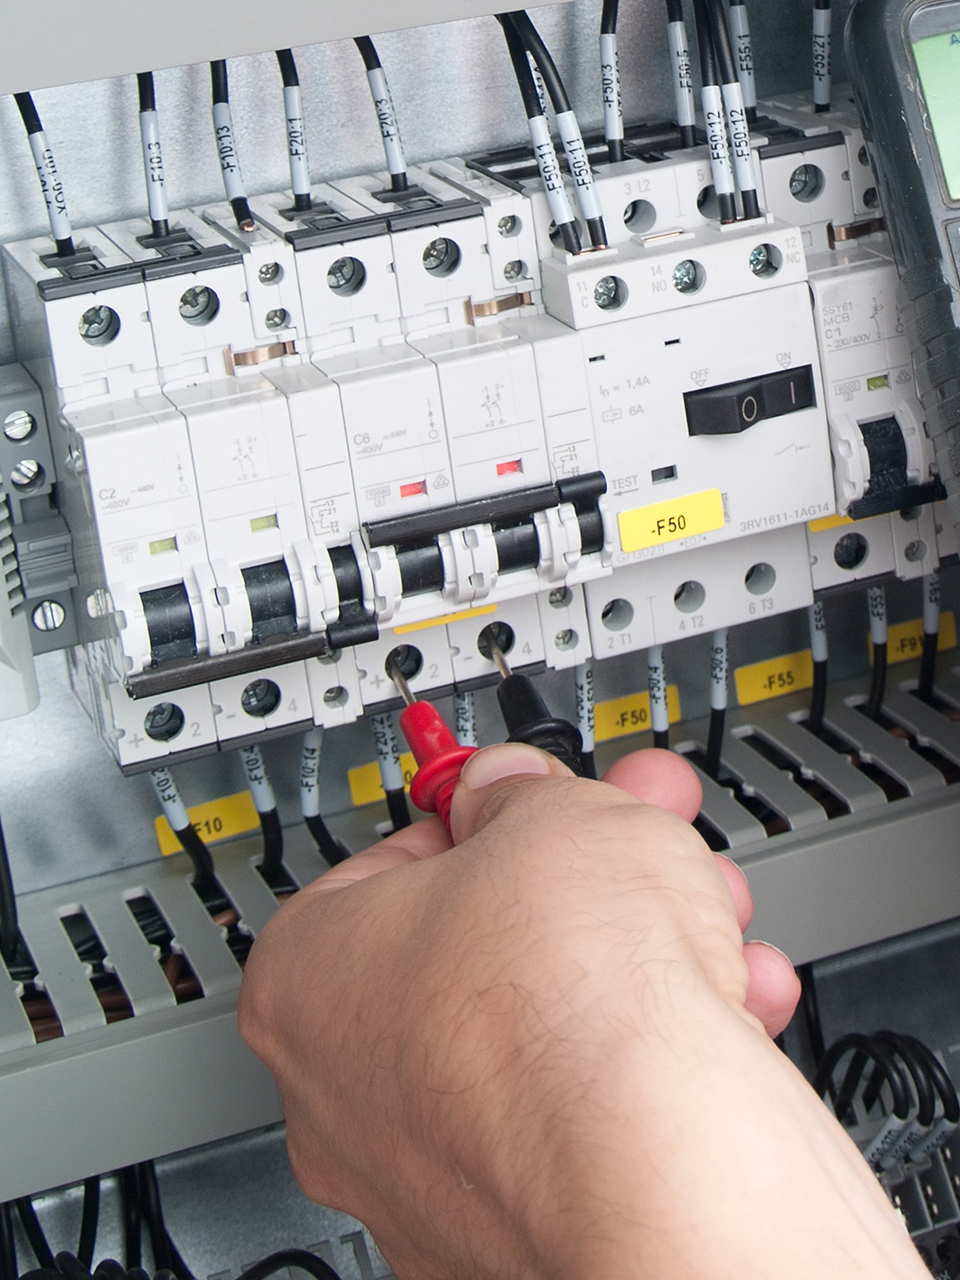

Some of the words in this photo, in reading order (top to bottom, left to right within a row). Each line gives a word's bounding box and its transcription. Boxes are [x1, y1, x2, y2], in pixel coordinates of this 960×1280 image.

[375, 97, 397, 142] -F20:3
[287, 116, 305, 161] -F20:1
[706, 110, 724, 165] -F50:12
[730, 107, 750, 162] -F50:12
[216, 125, 236, 173] -F10:13
[147, 141, 164, 187] -F10:3
[536, 142, 562, 195] -F50:11
[567, 137, 594, 191] -F50:11
[624, 182, 632, 195] 3
[638, 179, 651, 193] L2
[785, 237, 797, 248] 12
[786, 252, 801, 265] NC
[650, 264, 662, 277] 14
[576, 280, 587, 292] 11
[651, 279, 667, 293] NO
[581, 296, 589, 308] C
[823, 312, 850, 327] MCB
[776, 351, 792, 363] ON
[690, 368, 710, 381] OFF
[626, 375, 651, 390] 1,4A
[629, 404, 645, 417] 6A
[353, 432, 371, 446] C6
[611, 475, 639, 490] TEST
[98, 487, 117, 501] C2
[650, 514, 687, 536] -F50
[739, 503, 830, 532] 3RV1611-1AG14
[748, 601, 757, 614] 6
[760, 598, 774, 612] T3
[679, 619, 687, 631] 4
[619, 632, 633, 646] T1
[521, 641, 532, 656] 4
[429, 663, 440, 679] 2
[762, 670, 795, 690] -F55
[287, 698, 298, 713] 4
[615, 708, 648, 727] -F50
[190, 722, 202, 737] 2
[301, 746, 318, 793] -F10:14
